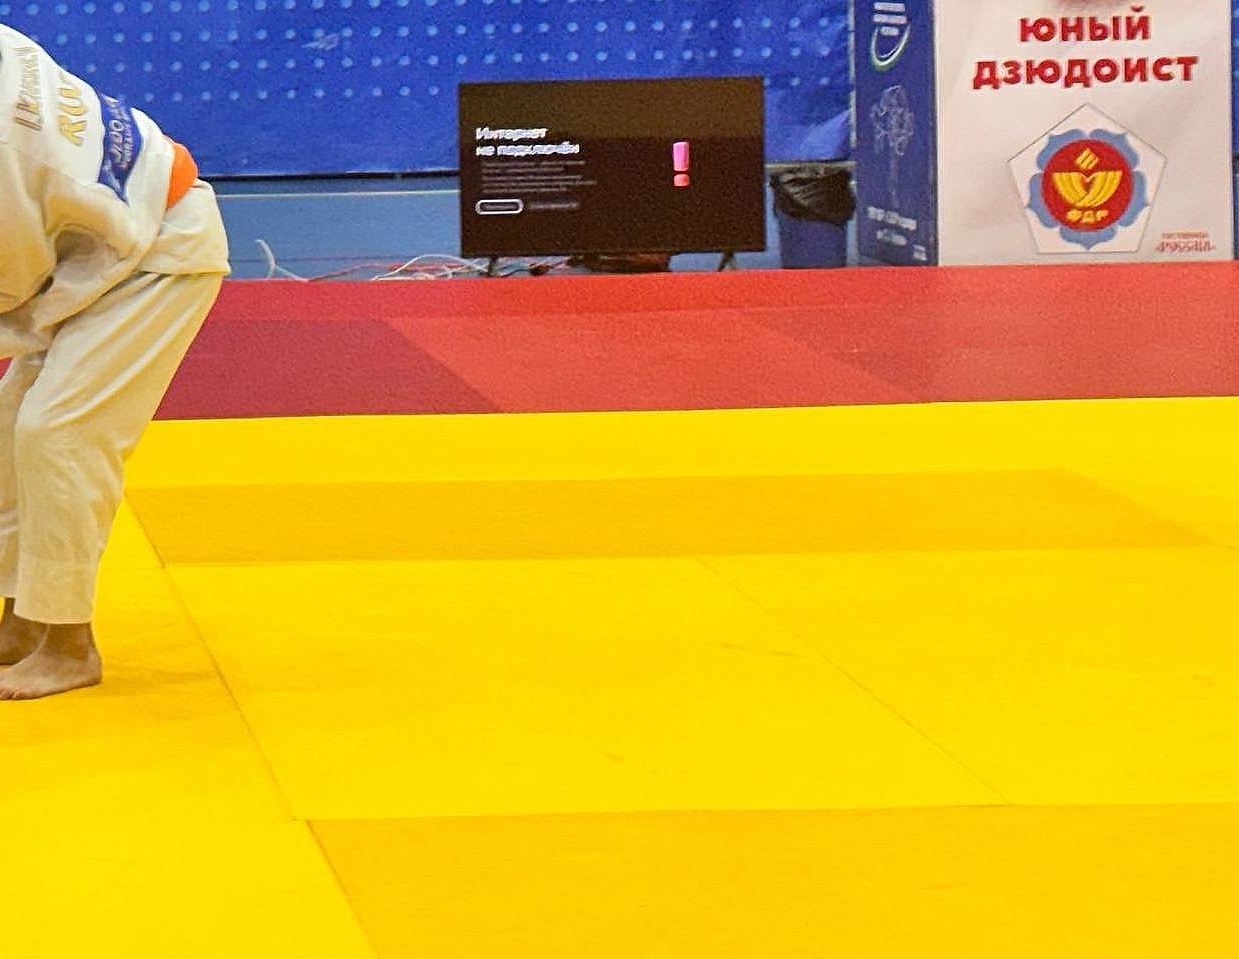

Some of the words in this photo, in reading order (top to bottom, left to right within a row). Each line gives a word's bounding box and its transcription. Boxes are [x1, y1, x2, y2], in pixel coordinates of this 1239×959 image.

[1020, 5, 1152, 42] ЮНЫЙ
[972, 55, 1200, 90] ДЗЮДОИСТ
[57, 81, 88, 146] RU
